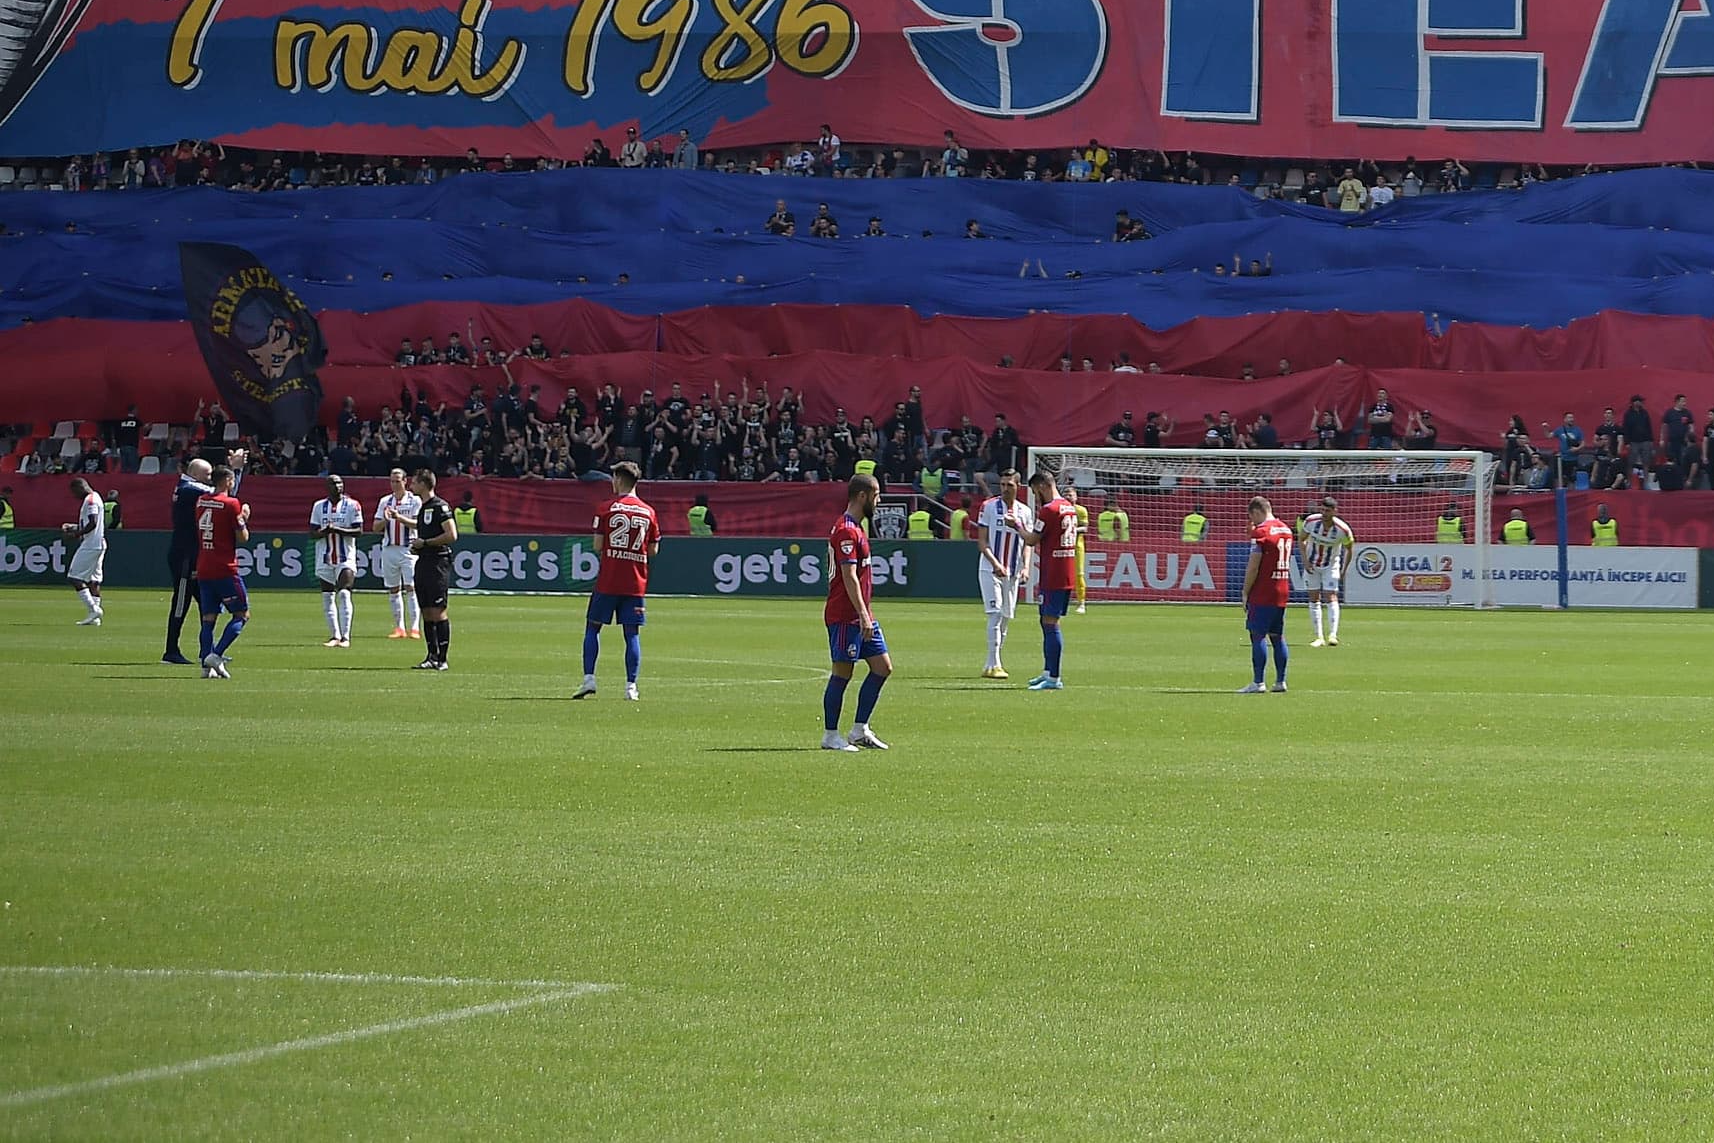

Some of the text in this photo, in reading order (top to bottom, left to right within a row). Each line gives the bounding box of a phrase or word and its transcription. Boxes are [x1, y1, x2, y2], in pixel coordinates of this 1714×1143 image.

[198, 508, 213, 530] 4
[608, 513, 650, 551] 27
[871, 550, 908, 586] et
[1277, 538, 1293, 569] 11
[1391, 556, 1453, 572] LIGA 2
